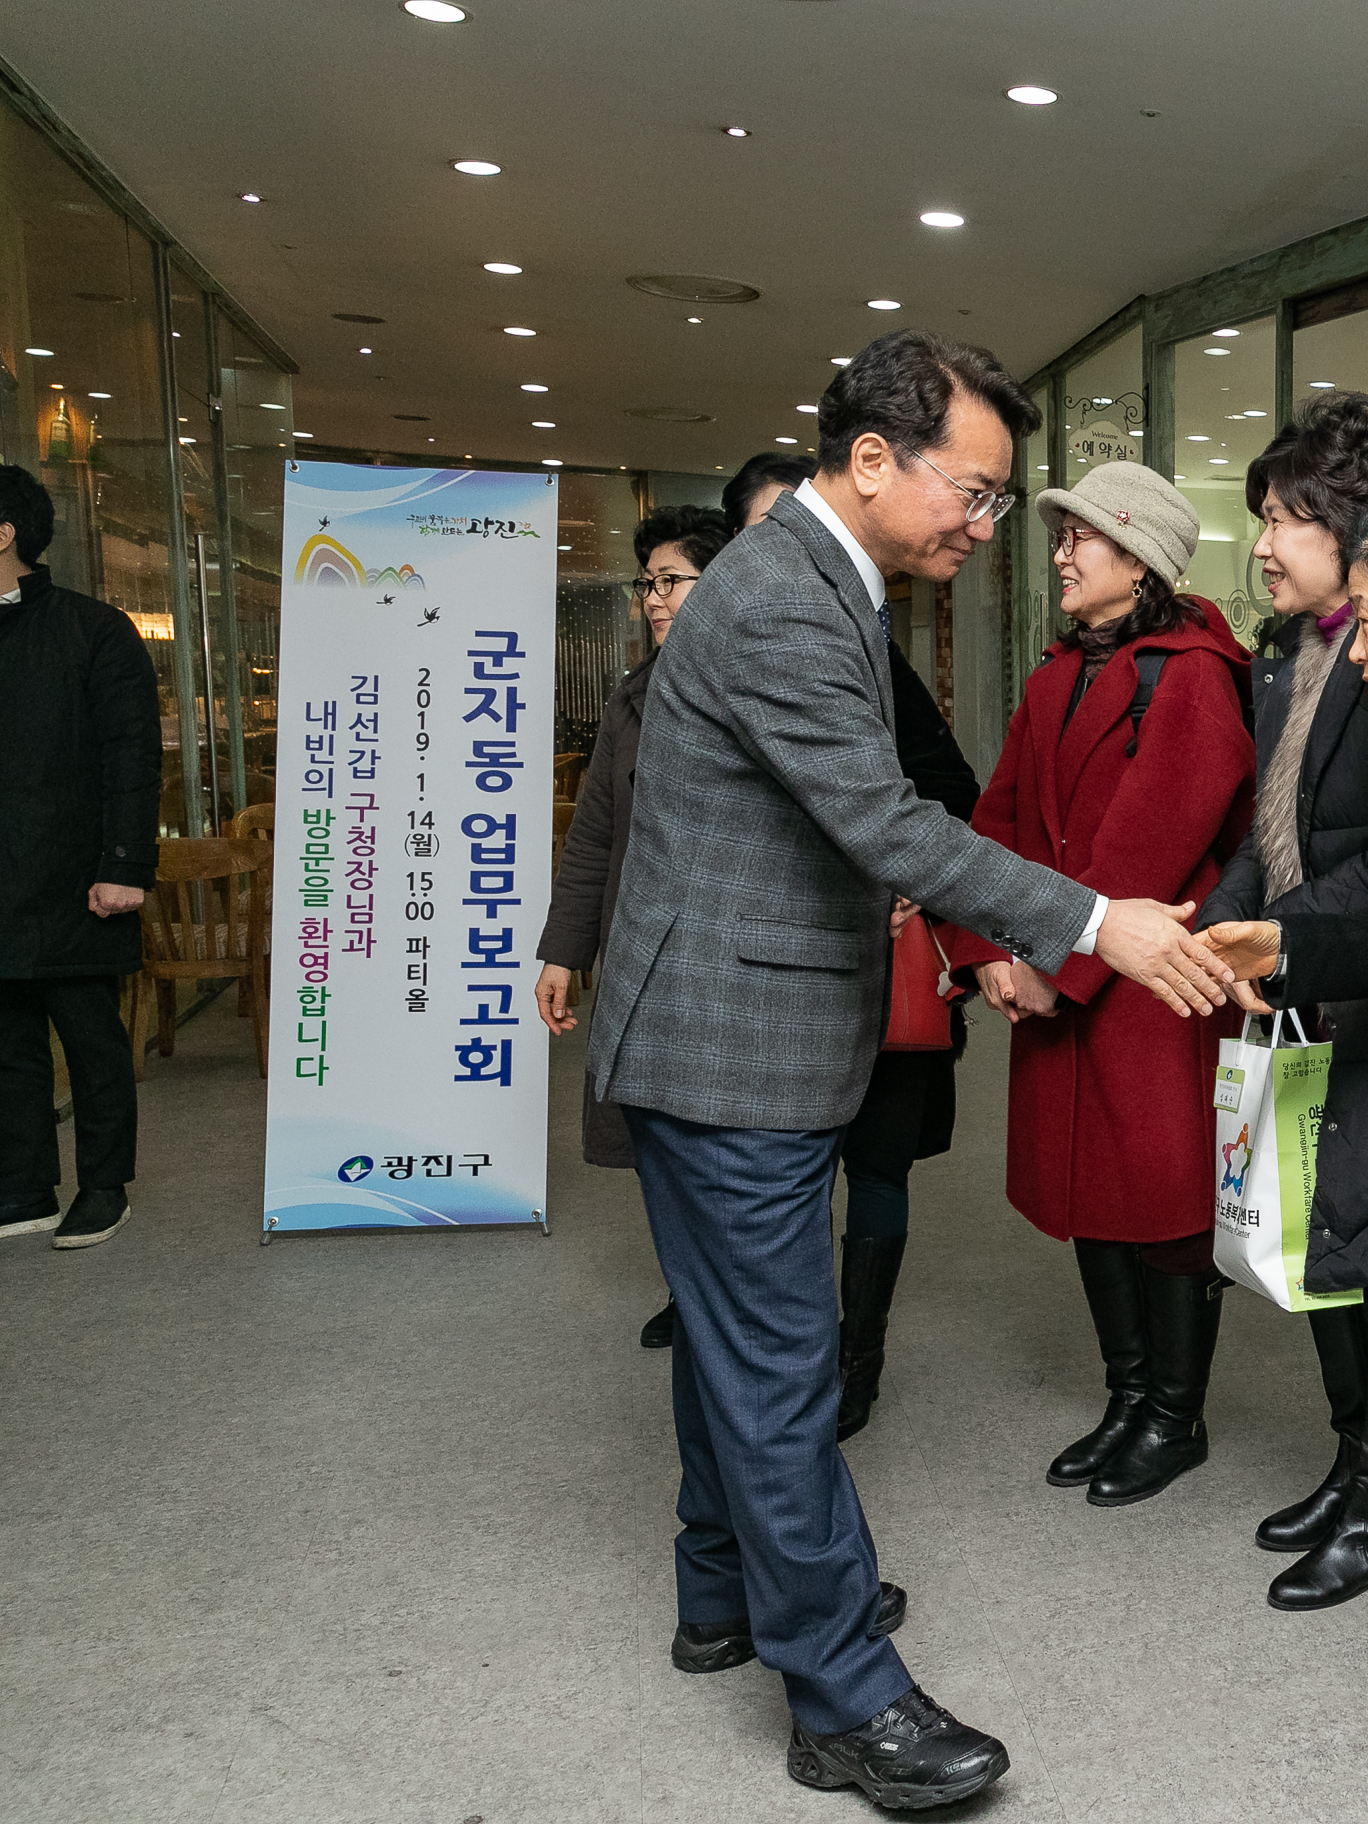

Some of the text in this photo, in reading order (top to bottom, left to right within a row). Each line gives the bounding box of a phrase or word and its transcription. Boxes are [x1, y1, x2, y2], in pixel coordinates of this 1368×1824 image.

[1081, 439, 1128, 461] 예약실
[1091, 430, 1119, 441] Welcome
[465, 516, 519, 539] 광진
[341, 673, 382, 960] 김선갑 구청장님과
[453, 629, 527, 1089] 군자동 업무보고회
[294, 700, 338, 1088] 내빈의 방문을 환영합니다
[404, 935, 431, 1013] 파티올
[1282, 1061, 1301, 1071] 당신의
[1291, 1066, 1322, 1078] 고맙습니다
[1297, 1113, 1310, 1171] Gwangjin-gu
[380, 1153, 493, 1181] 광진구
[1302, 1171, 1313, 1213] Workfare
